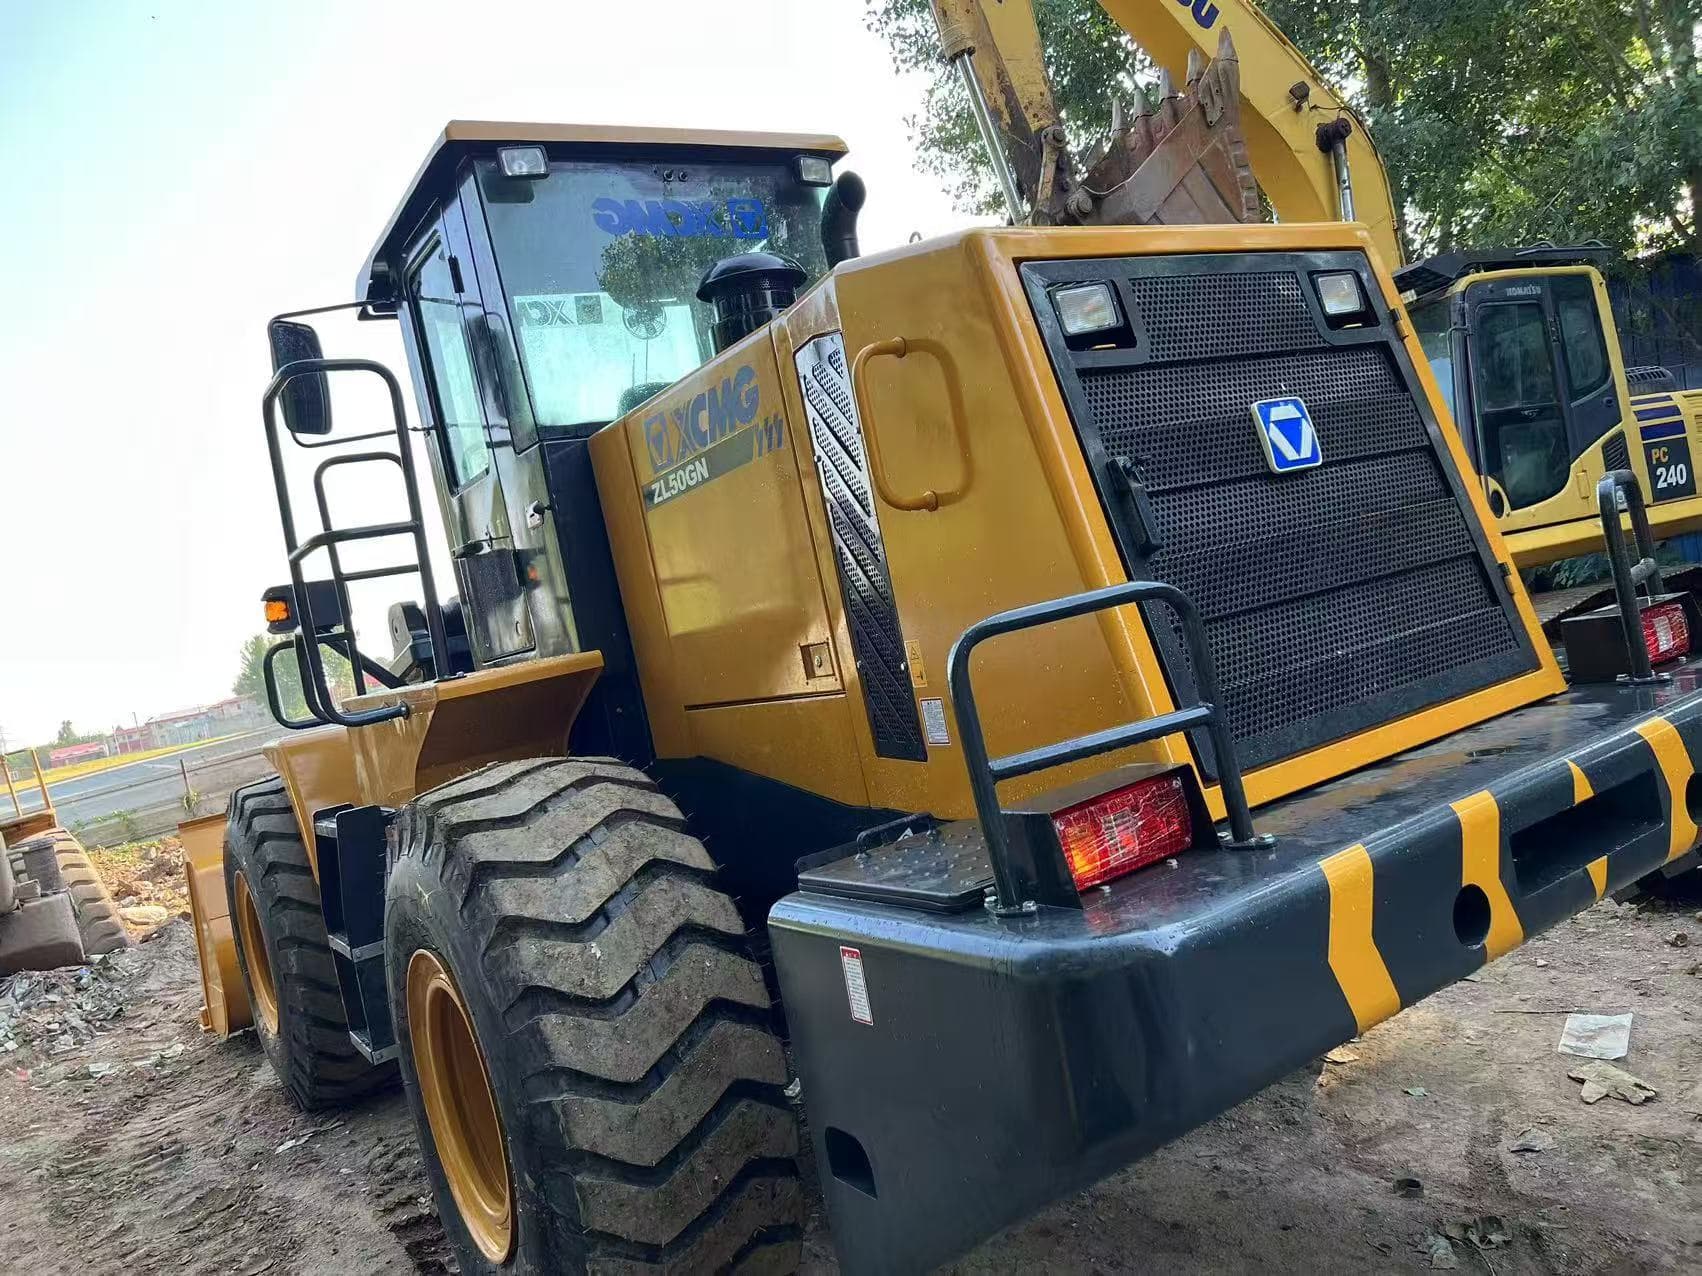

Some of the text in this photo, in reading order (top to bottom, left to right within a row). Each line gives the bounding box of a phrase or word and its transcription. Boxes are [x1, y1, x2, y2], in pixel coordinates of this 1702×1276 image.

[671, 365, 760, 464] XCMG
[1651, 446, 1669, 464] PC
[651, 457, 710, 504] ZL50GN
[1656, 463, 1687, 489] 240
